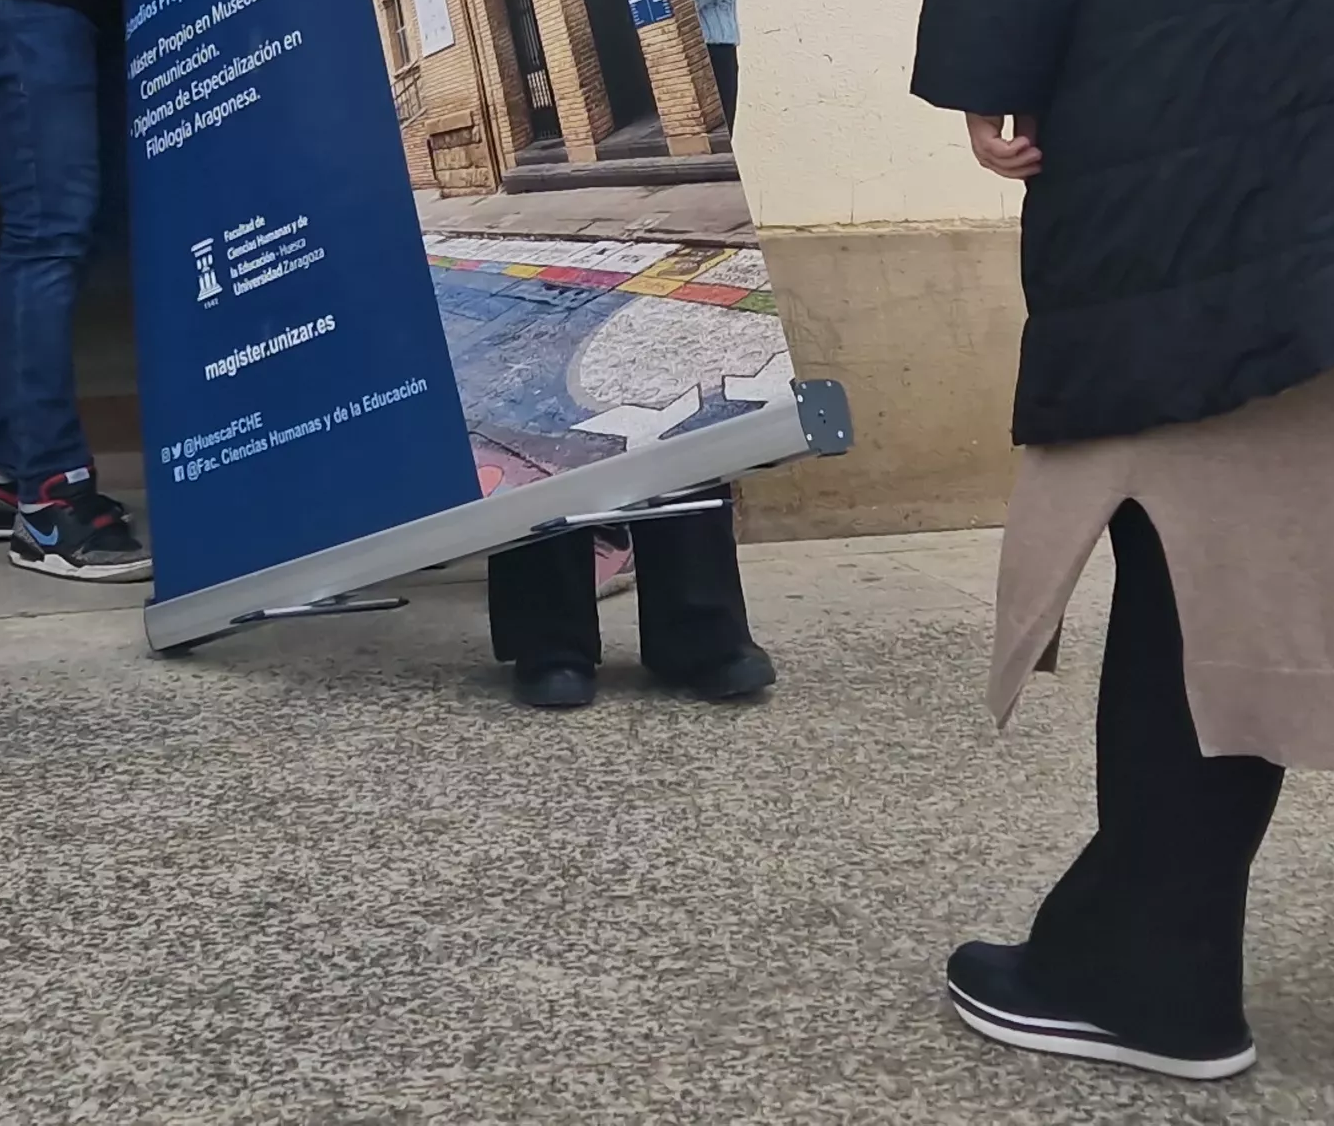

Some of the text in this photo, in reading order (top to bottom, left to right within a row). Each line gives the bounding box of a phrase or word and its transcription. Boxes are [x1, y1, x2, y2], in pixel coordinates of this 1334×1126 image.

[158, 24, 194, 56] Propio
[195, 14, 211, 34] en
[133, 29, 302, 139] Diploma de Especialización en
[140, 42, 220, 100] Comunicación.
[146, 85, 261, 160] Filología Aragonesa.
[282, 247, 325, 274] Zaragoza
[204, 314, 335, 381] magister.unizar.es
[183, 412, 264, 459] @HuescaFCHE
[186, 376, 428, 482] @Fac. Ciencias Humanas y de la Educación
